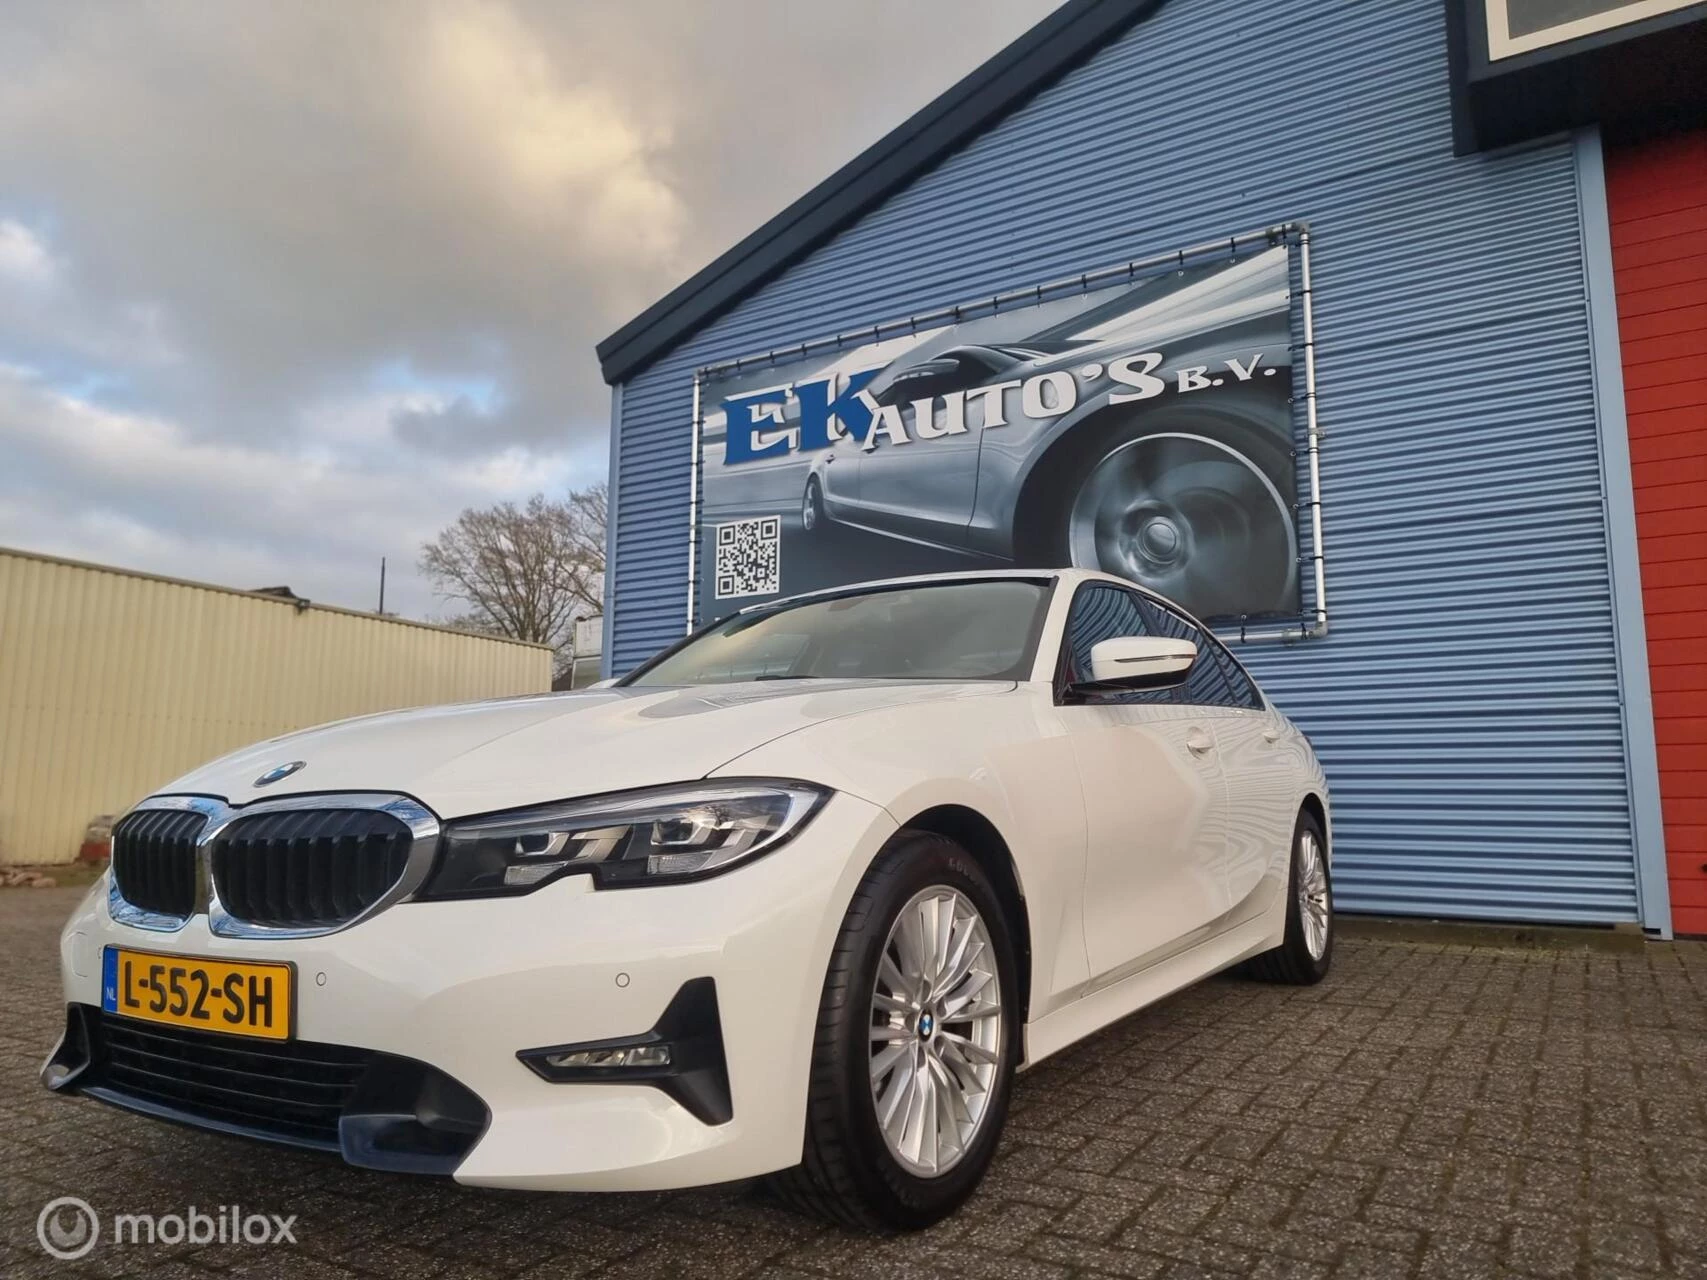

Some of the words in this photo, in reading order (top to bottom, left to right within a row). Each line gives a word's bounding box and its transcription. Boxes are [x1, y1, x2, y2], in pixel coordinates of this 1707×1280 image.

[720, 366, 888, 466] EK
[1176, 353, 1277, 393] B.V.
[106, 986, 116, 1001] NL
[124, 960, 273, 1028] L-552-SH
